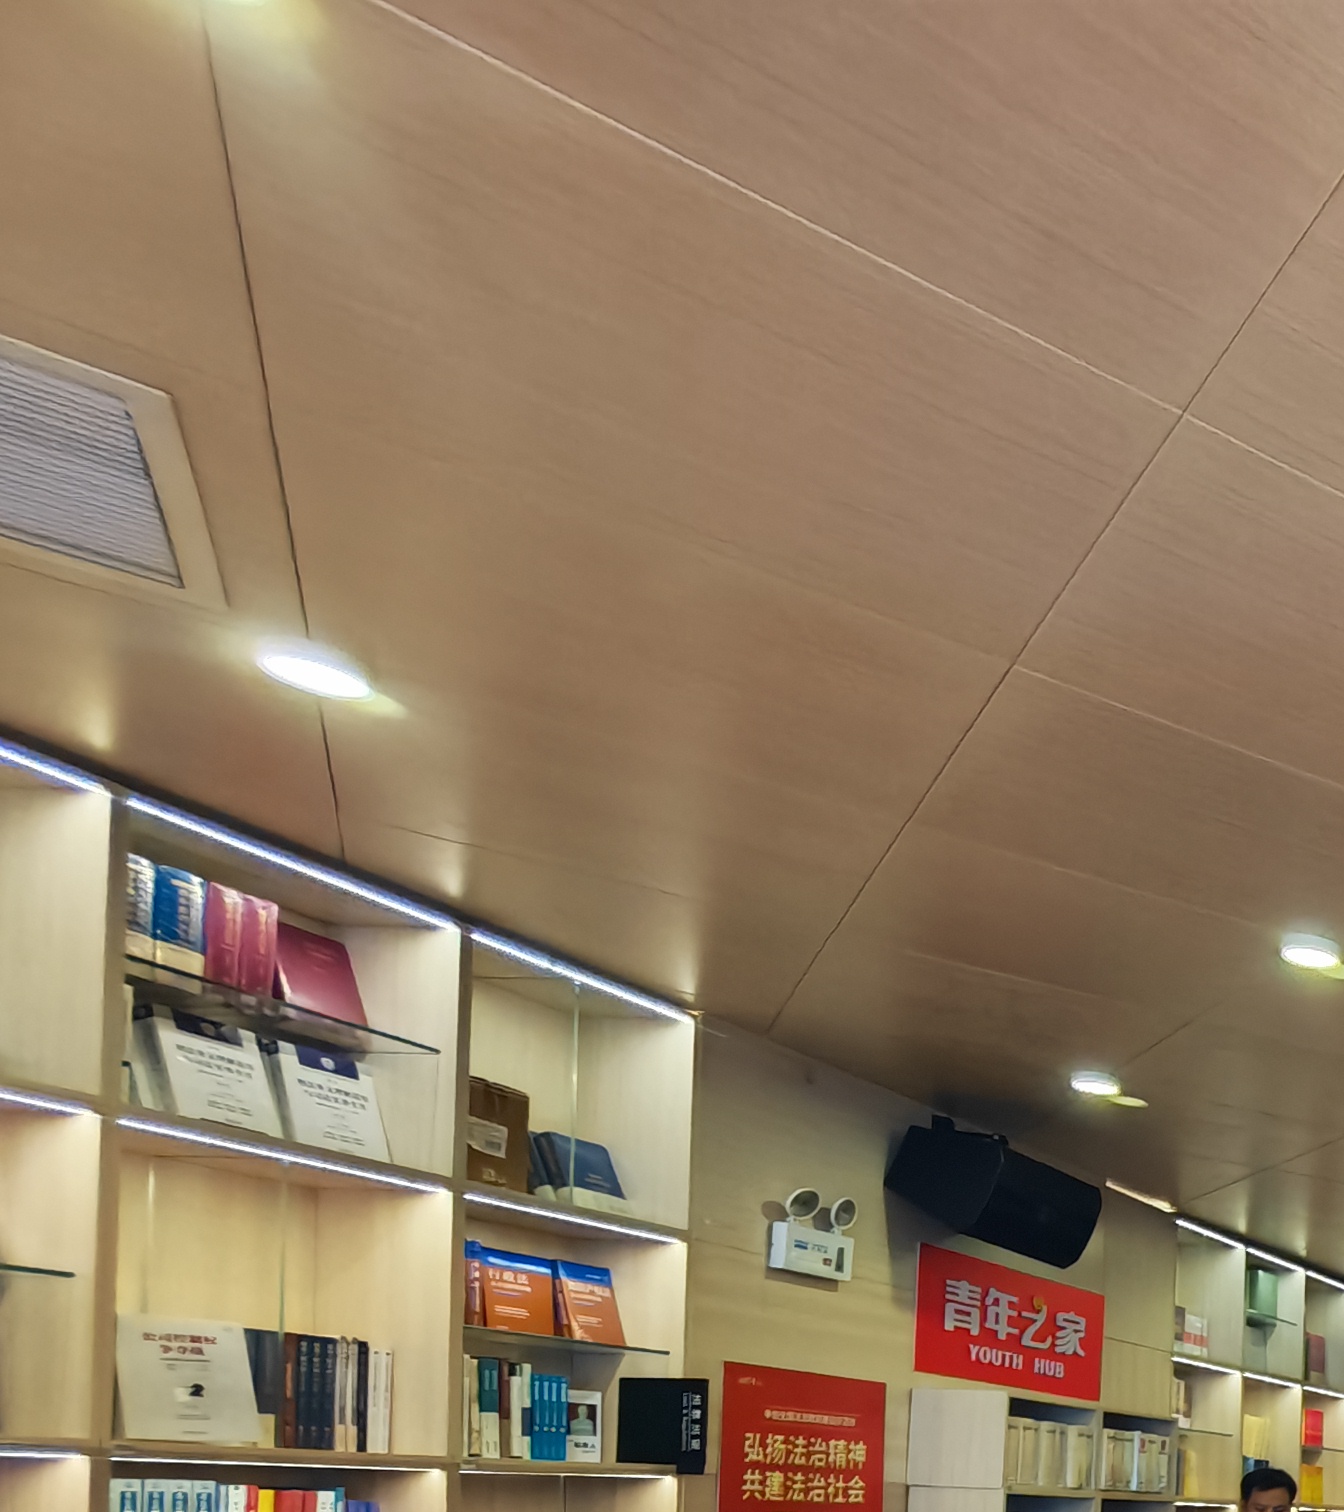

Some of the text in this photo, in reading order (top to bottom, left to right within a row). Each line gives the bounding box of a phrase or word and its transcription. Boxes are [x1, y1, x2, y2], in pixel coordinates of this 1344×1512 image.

[944, 1279, 1087, 1358] 青年之家
[968, 1343, 1065, 1379] YOUTH HUB
[743, 1432, 868, 1470] 弘扬法治精神
[741, 1469, 867, 1504] 共建法治社会
